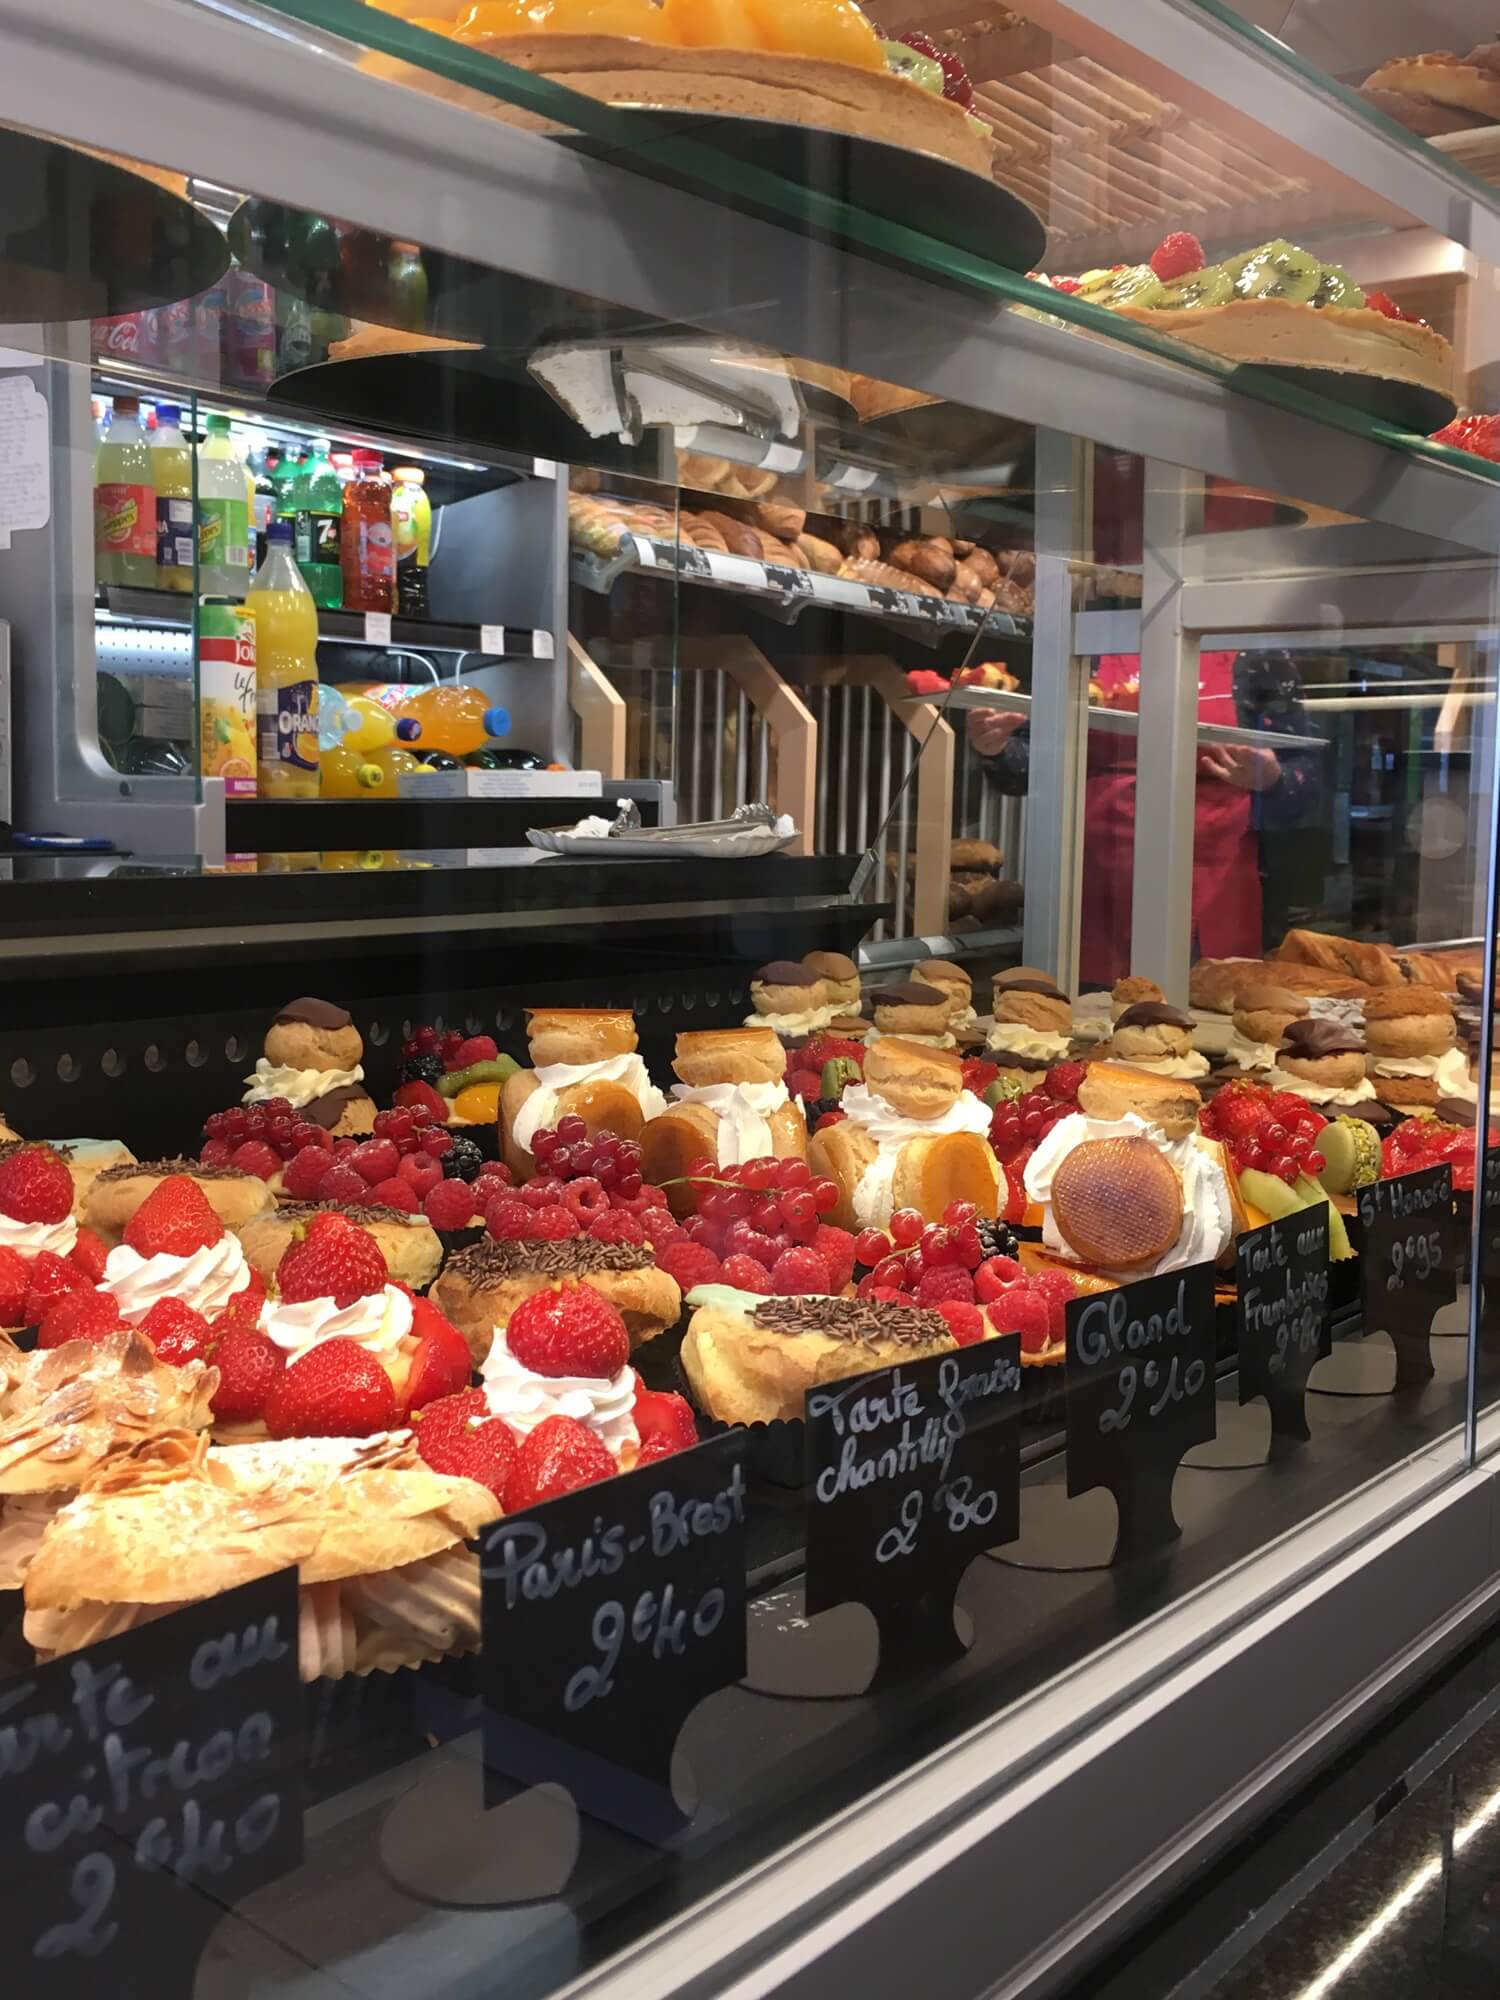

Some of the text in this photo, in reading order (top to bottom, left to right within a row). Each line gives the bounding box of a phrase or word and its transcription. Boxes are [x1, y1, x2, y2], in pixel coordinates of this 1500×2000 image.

[1238, 1224, 1289, 1278] Tarte
[1075, 1279, 1193, 1365] Gland
[808, 1367, 926, 1436] Tarte
[481, 1462, 747, 1610] Paris-Brest
